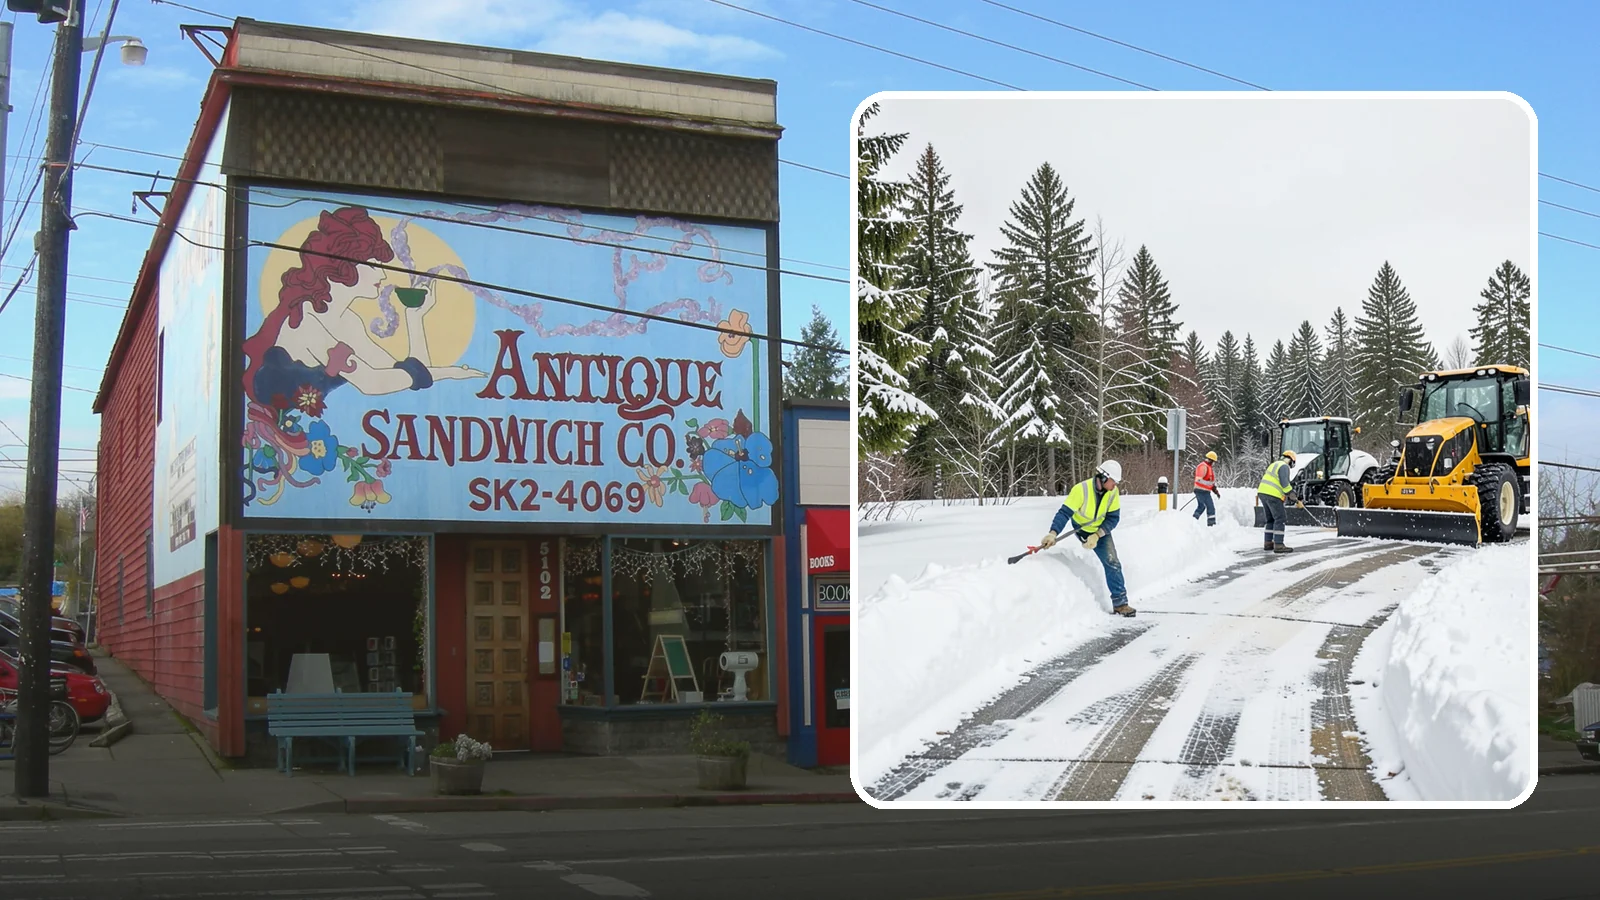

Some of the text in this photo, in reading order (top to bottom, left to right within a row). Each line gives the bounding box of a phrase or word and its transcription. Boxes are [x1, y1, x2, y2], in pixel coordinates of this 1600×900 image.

[475, 328, 724, 421] ANTIQUE
[361, 408, 685, 468] SANDWICH CO.
[468, 477, 646, 513] SK2-4069
[540, 541, 552, 600] 5102
[809, 555, 835, 569] BOOKS
